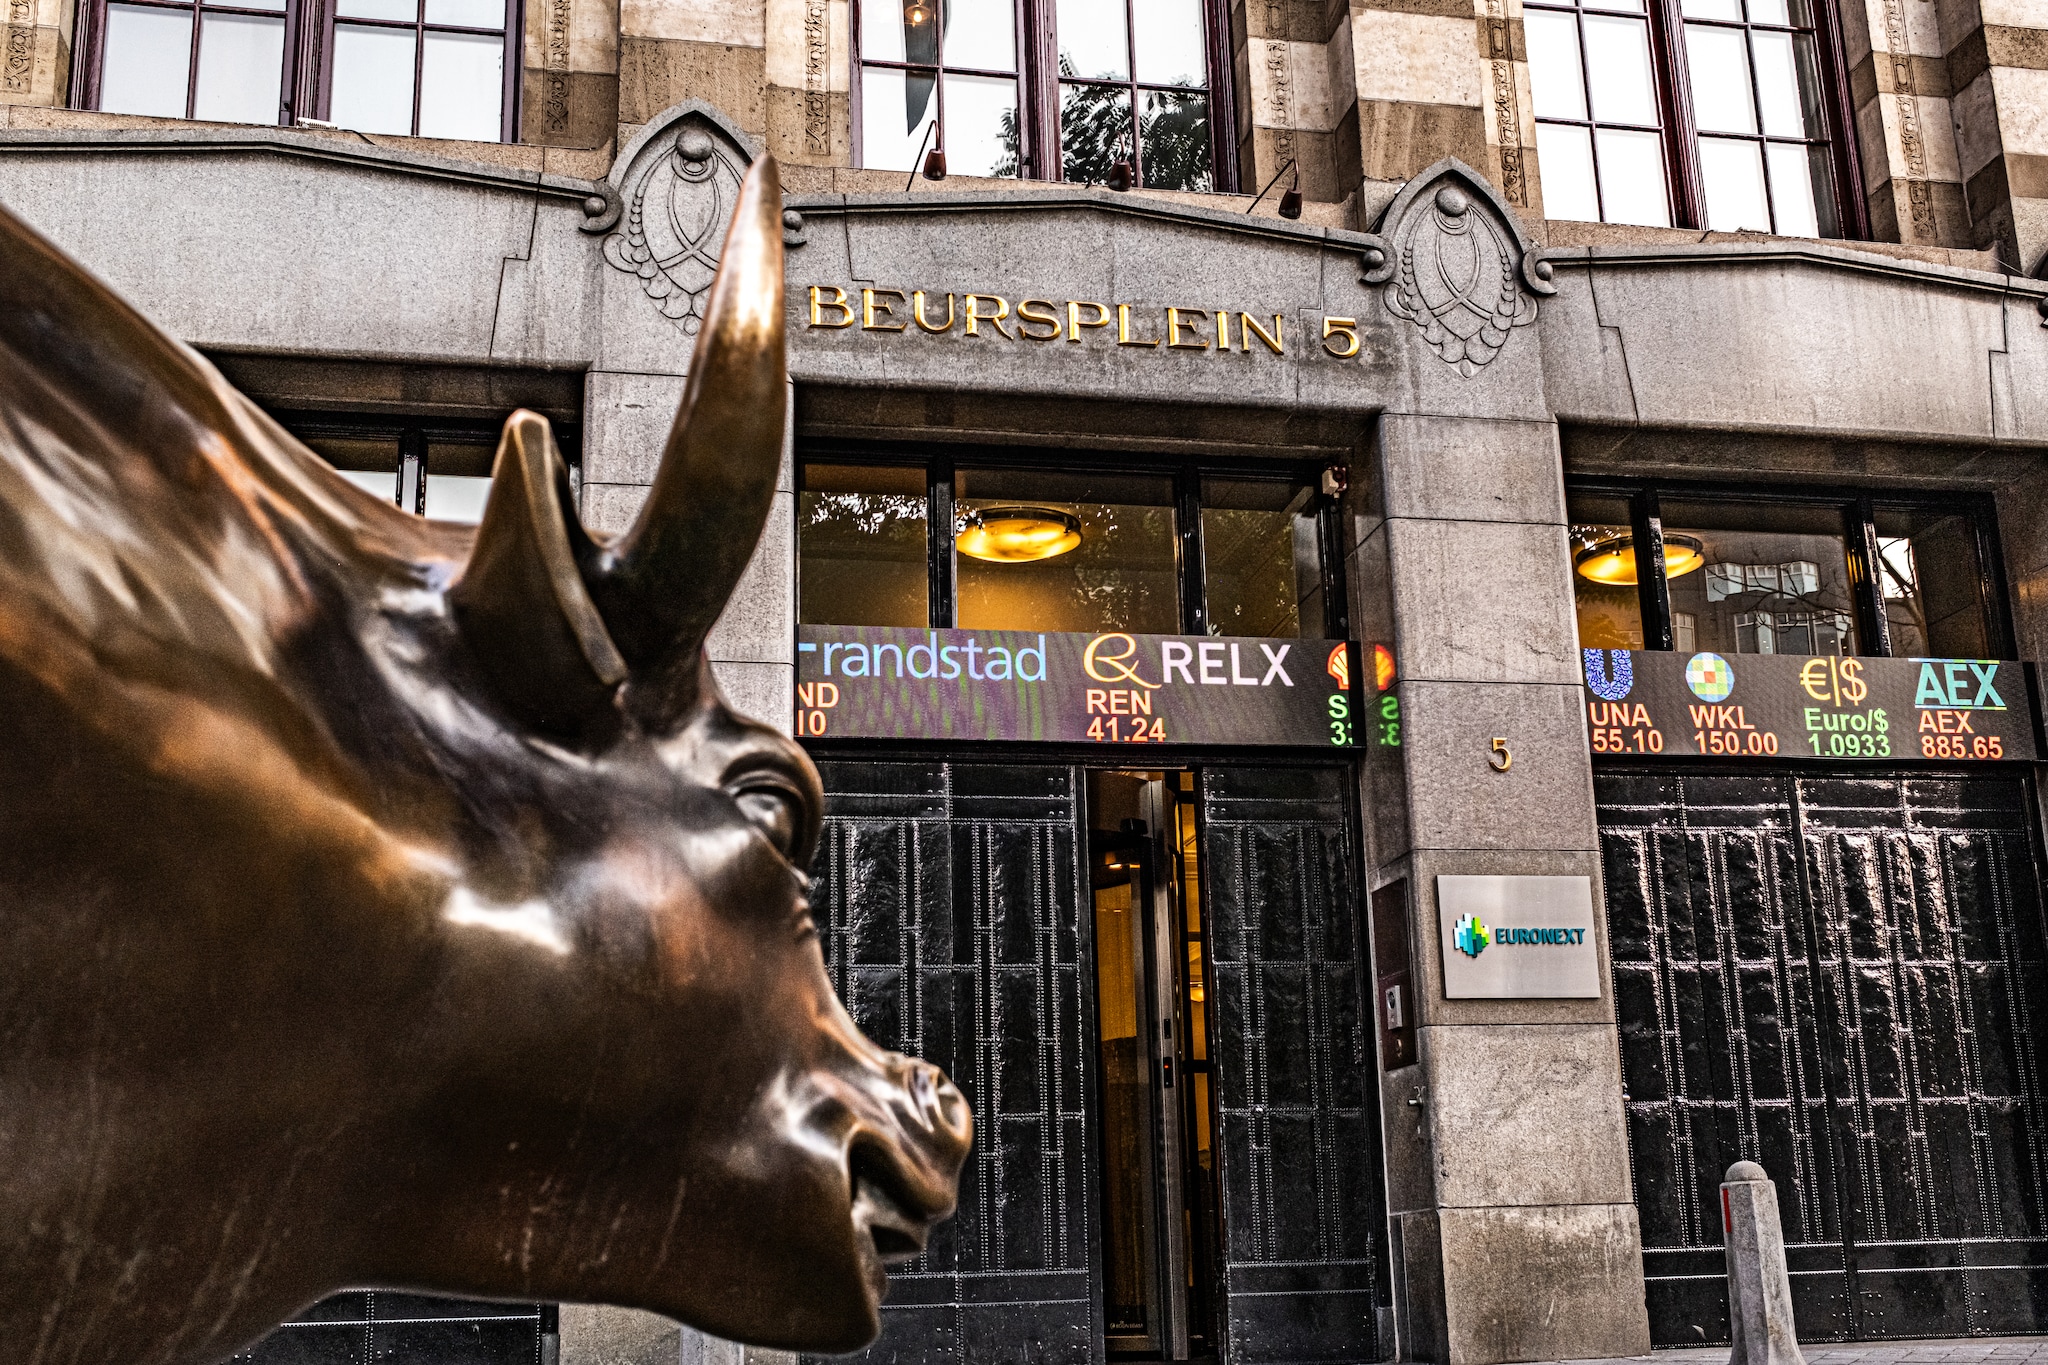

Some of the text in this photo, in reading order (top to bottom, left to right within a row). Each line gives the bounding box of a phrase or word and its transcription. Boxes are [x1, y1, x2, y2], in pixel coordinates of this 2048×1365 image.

[807, 285, 1360, 358] BEURSPLEIN 5
[823, 633, 1046, 681] randstad
[1162, 641, 1294, 687] RELX
[1914, 663, 2004, 706] AEX
[1086, 690, 1151, 714] REN
[1590, 703, 1653, 728] UNA
[1688, 705, 1755, 729] WKL
[1804, 708, 1889, 734] Euro/$
[1919, 710, 1974, 734] AEX
[1086, 717, 1167, 743] 41.24
[1593, 729, 1664, 754] 55.10
[1489, 737, 1513, 772] 5
[1694, 731, 1778, 755] 150.00
[1808, 734, 1891, 757] 1.0933
[1921, 735, 2004, 759] 885.65
[1496, 928, 1586, 945] EURONEXT
